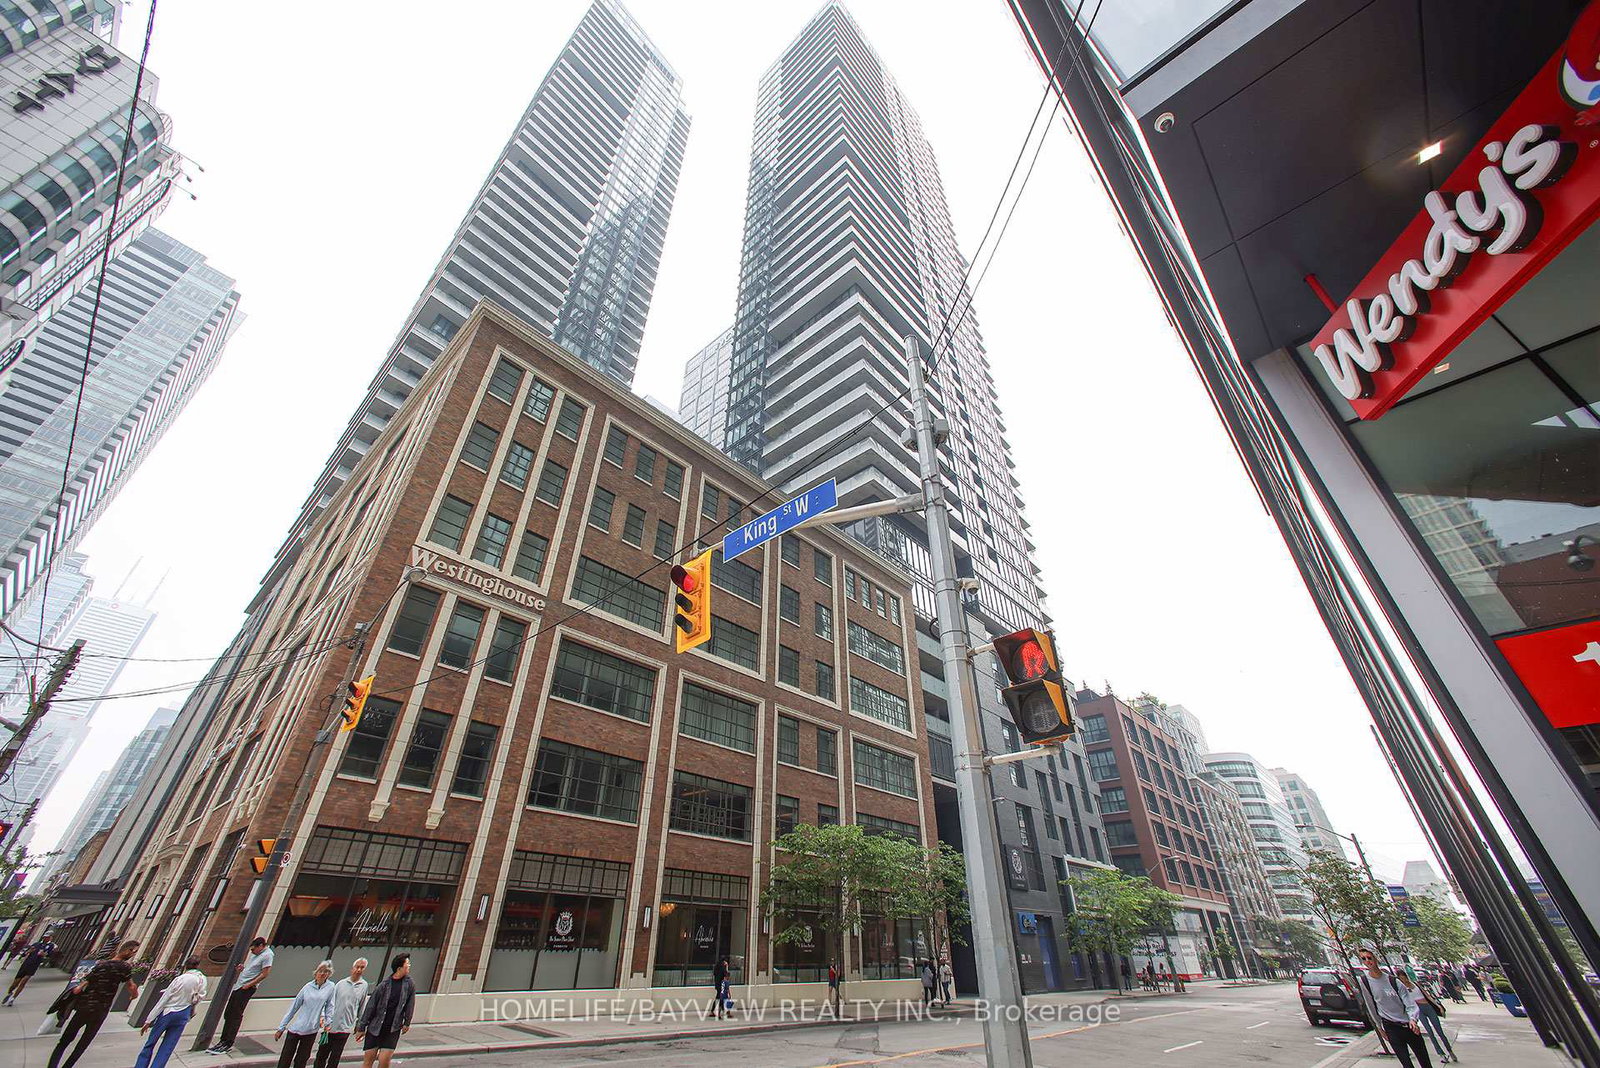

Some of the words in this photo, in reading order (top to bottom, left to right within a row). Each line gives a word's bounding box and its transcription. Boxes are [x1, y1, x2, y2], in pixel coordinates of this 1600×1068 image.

[13, 44, 121, 113] HYATT
[1314, 124, 1561, 400] Wendy's
[744, 515, 777, 544] King
[783, 504, 792, 516] St
[795, 494, 809, 517] W
[411, 545, 546, 611] Westinghouse
